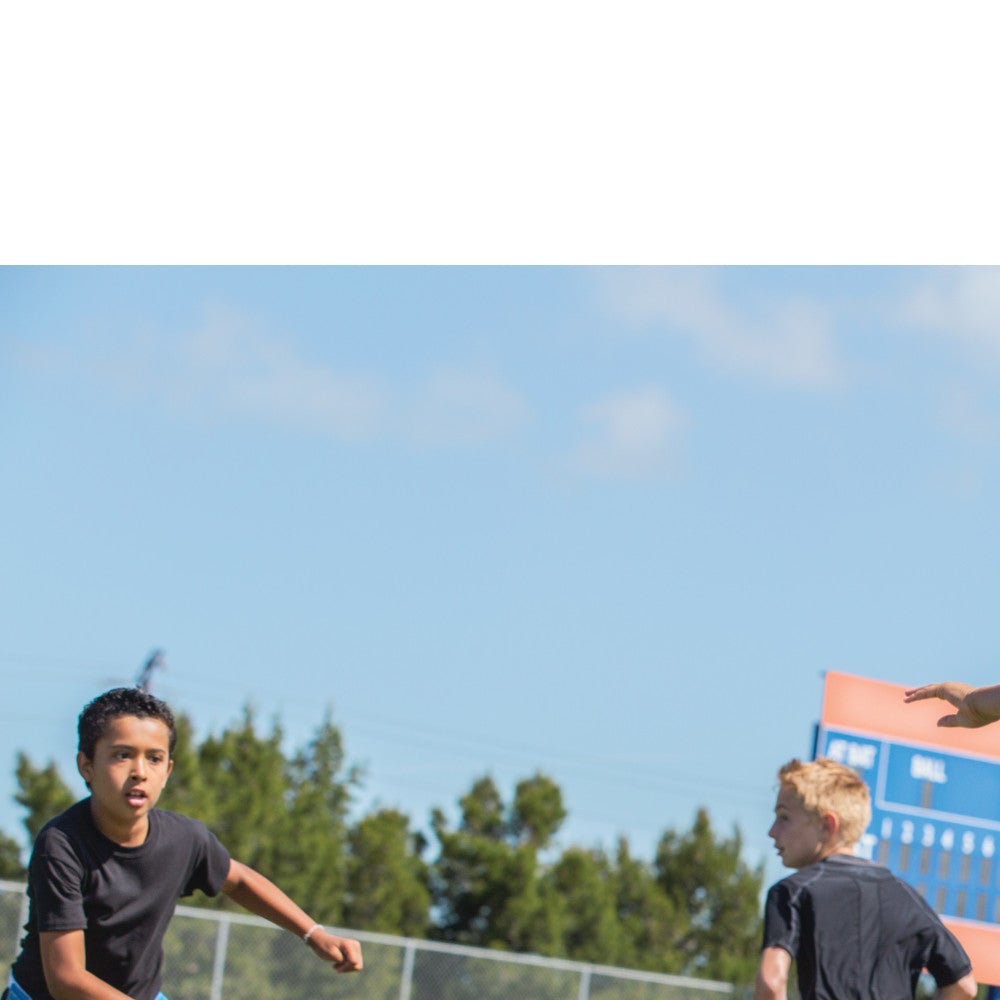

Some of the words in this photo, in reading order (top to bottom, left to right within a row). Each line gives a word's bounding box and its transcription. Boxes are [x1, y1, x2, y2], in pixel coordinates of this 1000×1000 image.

[911, 755, 947, 783] BALL
[881, 817, 893, 839] 1
[901, 820, 914, 844] 2
[922, 823, 935, 847] 3
[941, 828, 954, 850] 4
[962, 831, 975, 855] 5
[981, 835, 995, 858] 6
